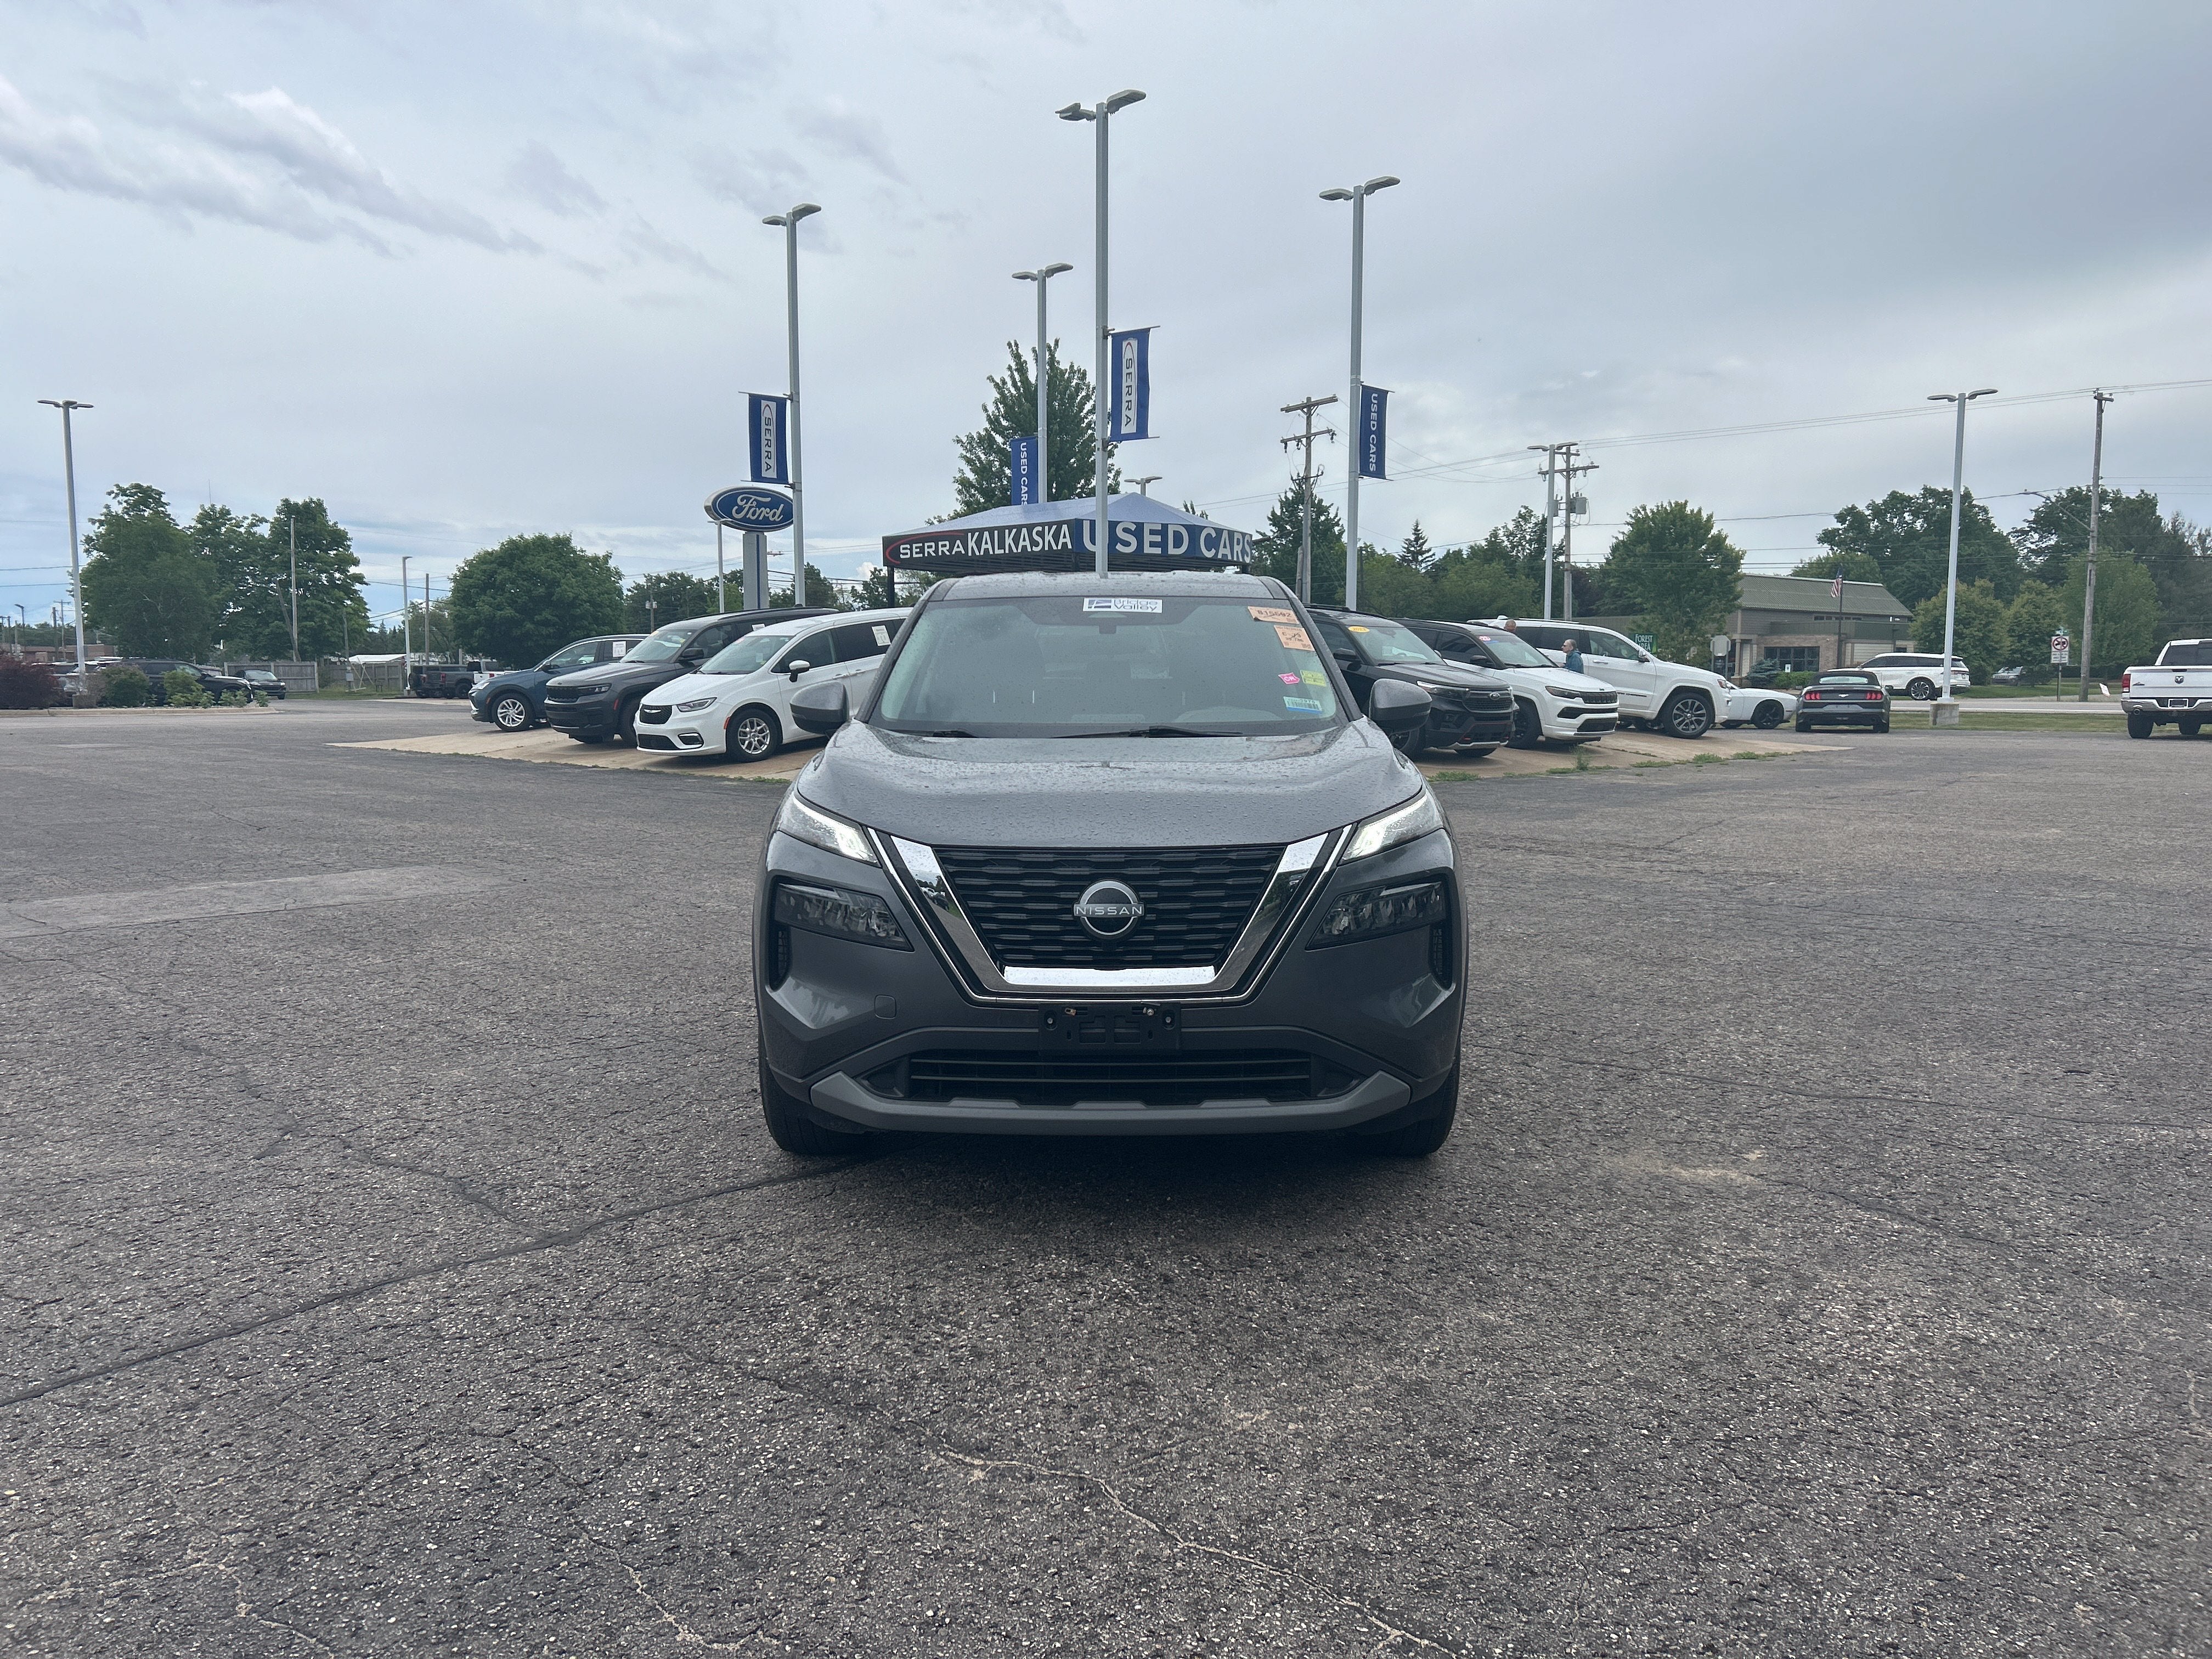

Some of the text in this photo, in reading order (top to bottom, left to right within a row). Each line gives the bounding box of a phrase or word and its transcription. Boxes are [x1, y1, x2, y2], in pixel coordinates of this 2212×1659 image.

[1125, 358, 1133, 427] SERRA
[1370, 393, 1378, 431] USED
[732, 494, 784, 522] Ford
[900, 524, 1072, 559] SERRA KALKASKA
[1200, 527, 1252, 563] CARS
[1635, 634, 1653, 643] FOREST
[1076, 906, 1142, 915] NISSAN
